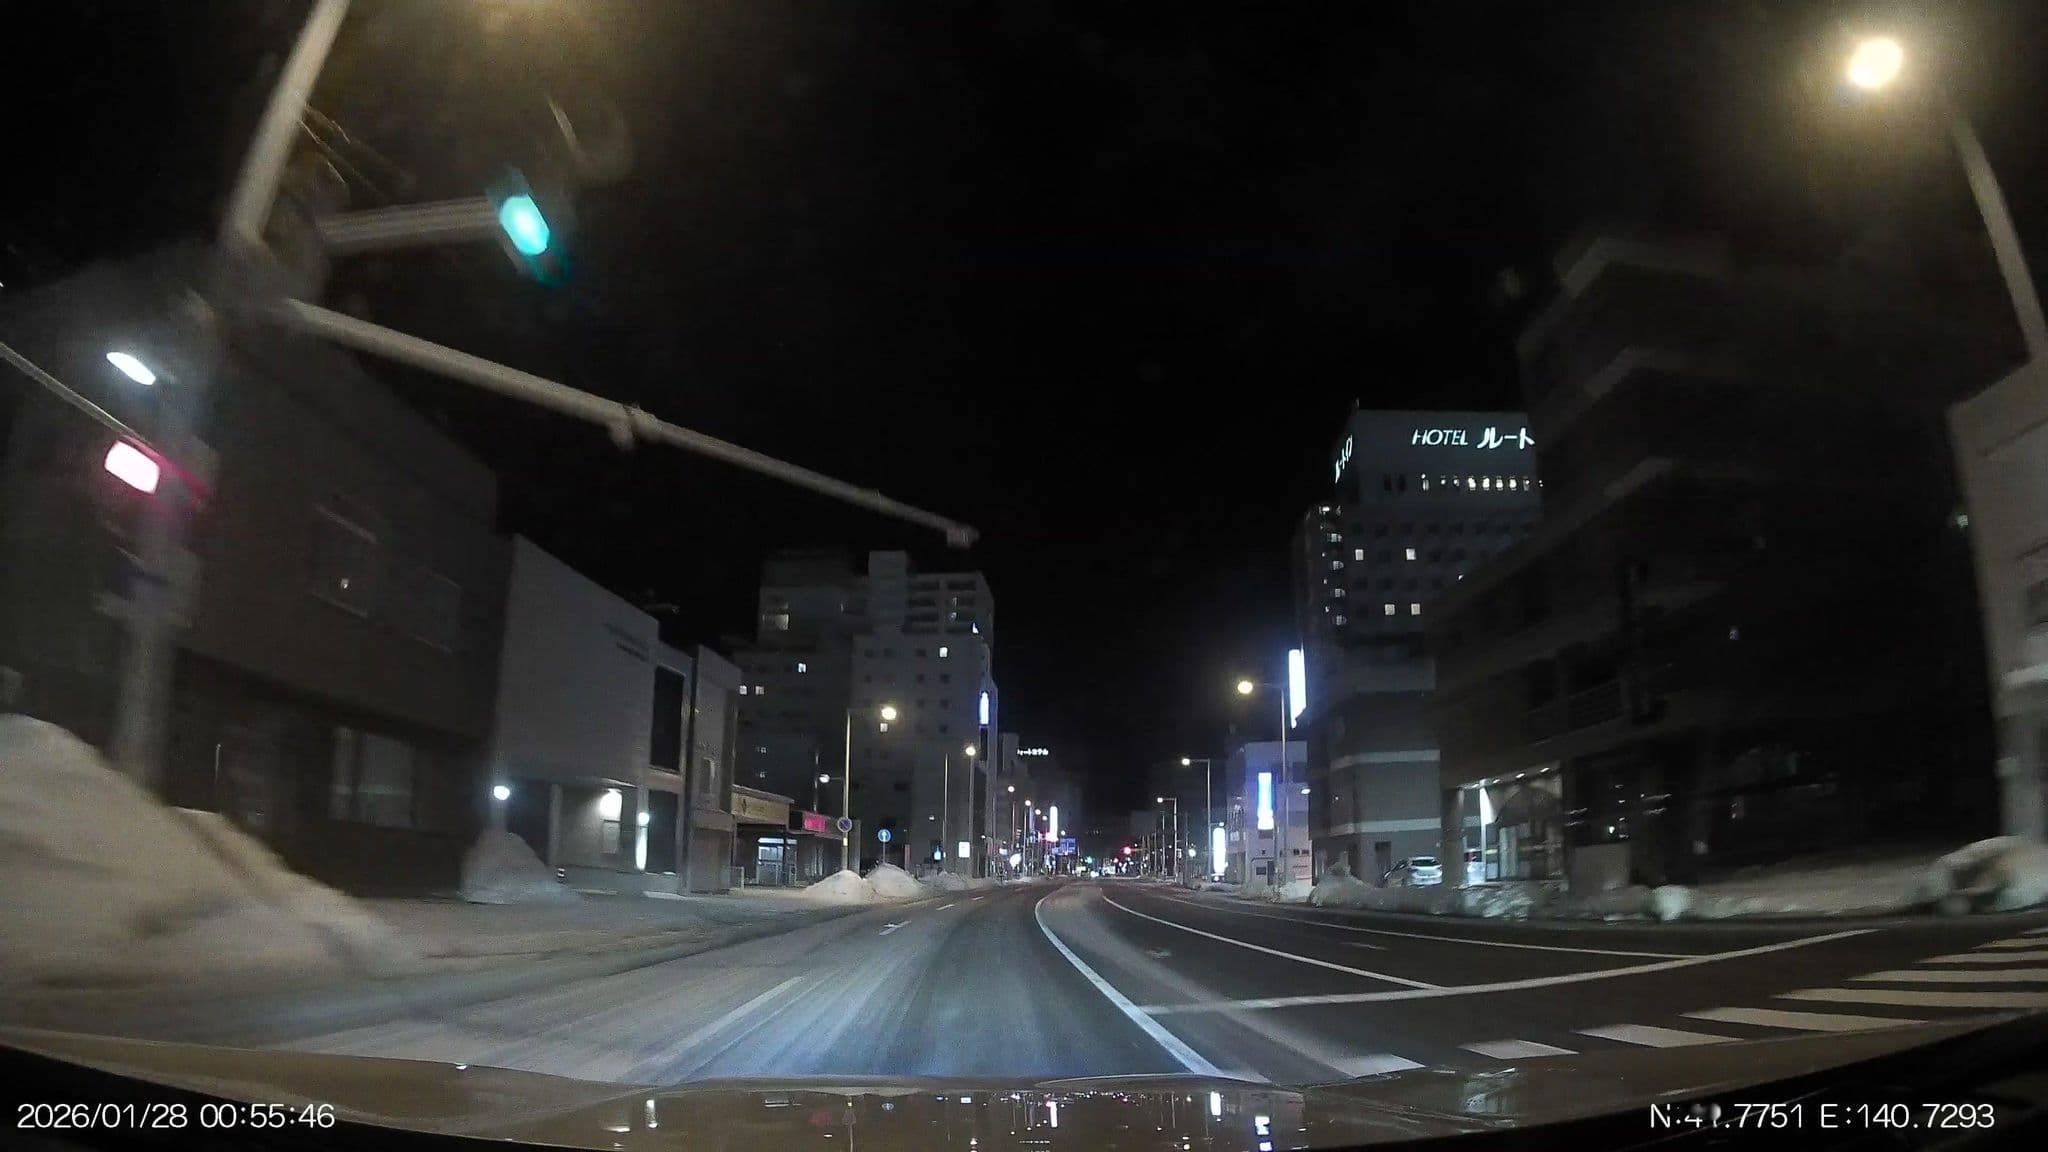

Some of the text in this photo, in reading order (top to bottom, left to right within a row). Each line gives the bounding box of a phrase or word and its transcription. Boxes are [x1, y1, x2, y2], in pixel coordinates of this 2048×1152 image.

[1411, 427, 1535, 450] HOTEL ルート
